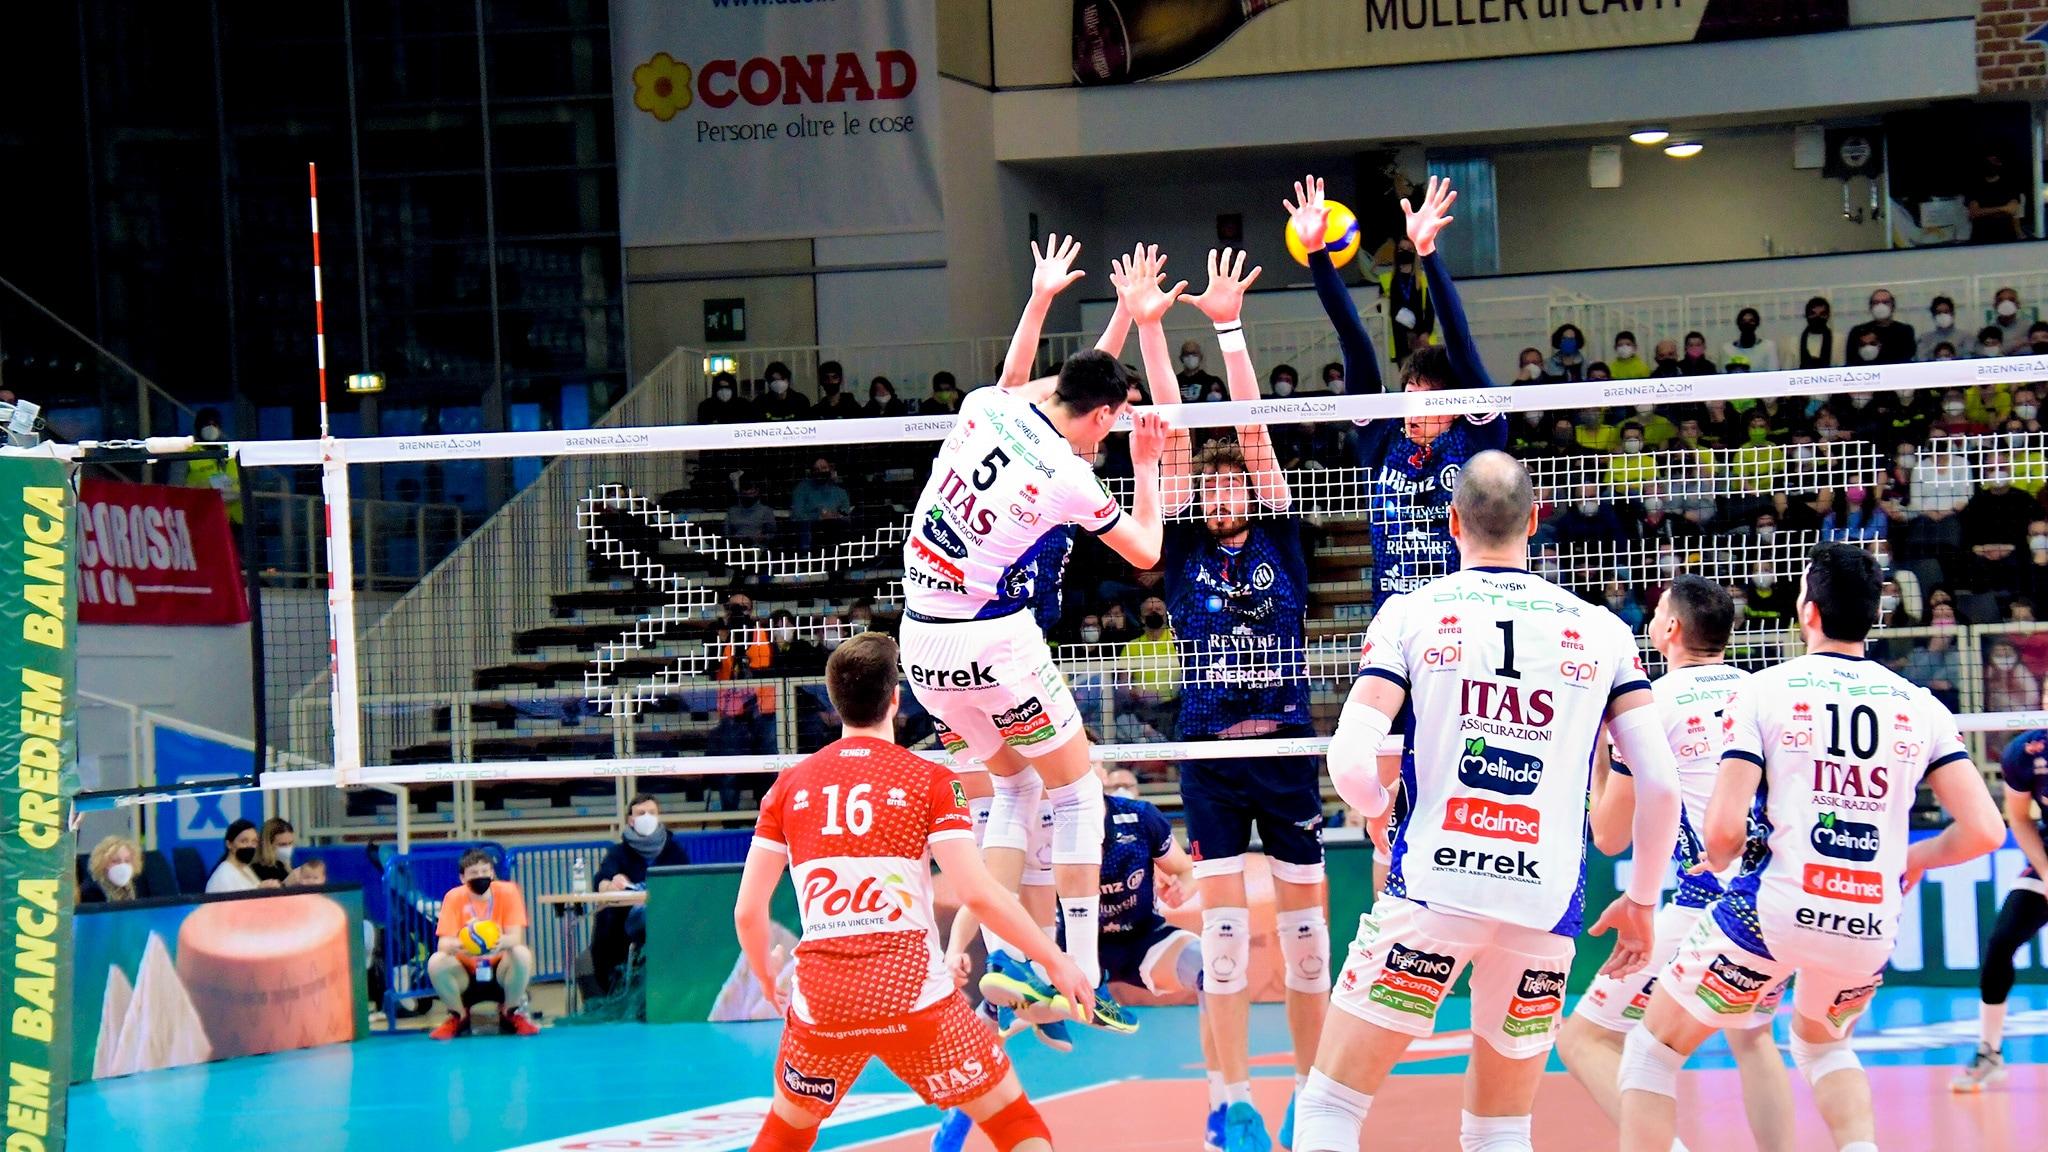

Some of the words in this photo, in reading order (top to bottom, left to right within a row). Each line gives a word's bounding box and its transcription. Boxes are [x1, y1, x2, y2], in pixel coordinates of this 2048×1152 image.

[697, 49, 918, 109] CONAD
[697, 120, 778, 143] Persone
[786, 114, 835, 138] oltre
[843, 112, 860, 135] le
[869, 114, 914, 133] cose
[973, 446, 1011, 491] 5
[938, 467, 998, 536] ITAS
[23, 487, 64, 649] BANCA
[909, 566, 968, 595] errek
[1438, 626, 1462, 635] errea
[1561, 639, 1584, 651] errea
[1495, 619, 1521, 680] 1
[911, 661, 997, 687] errek
[1206, 667, 1281, 683] ENERCOM
[1459, 678, 1554, 728] ITAS
[1460, 718, 1552, 742] ASSICURAZIONI
[1826, 703, 1879, 760] 10
[18, 668, 63, 849] CREDEM
[839, 749, 871, 757] ZENGER
[1460, 755, 1542, 783] Melinda
[1812, 759, 1889, 799] ITAS
[821, 783, 873, 836] 16
[1470, 806, 1538, 837] dalmec
[1434, 847, 1540, 879] errek
[803, 867, 888, 920] Poli
[1826, 872, 1881, 897] dalmec
[806, 922, 827, 934] PESA
[828, 922, 835, 930] SI
[836, 920, 846, 928] FA
[849, 917, 884, 928] VINCENTE
[1796, 907, 1883, 936] errek
[11, 879, 59, 1042] BANCA
[1391, 949, 1450, 975] TRENTINO
[809, 1023, 907, 1039] www.gruppopoli.it
[925, 1056, 983, 1092] ITAS
